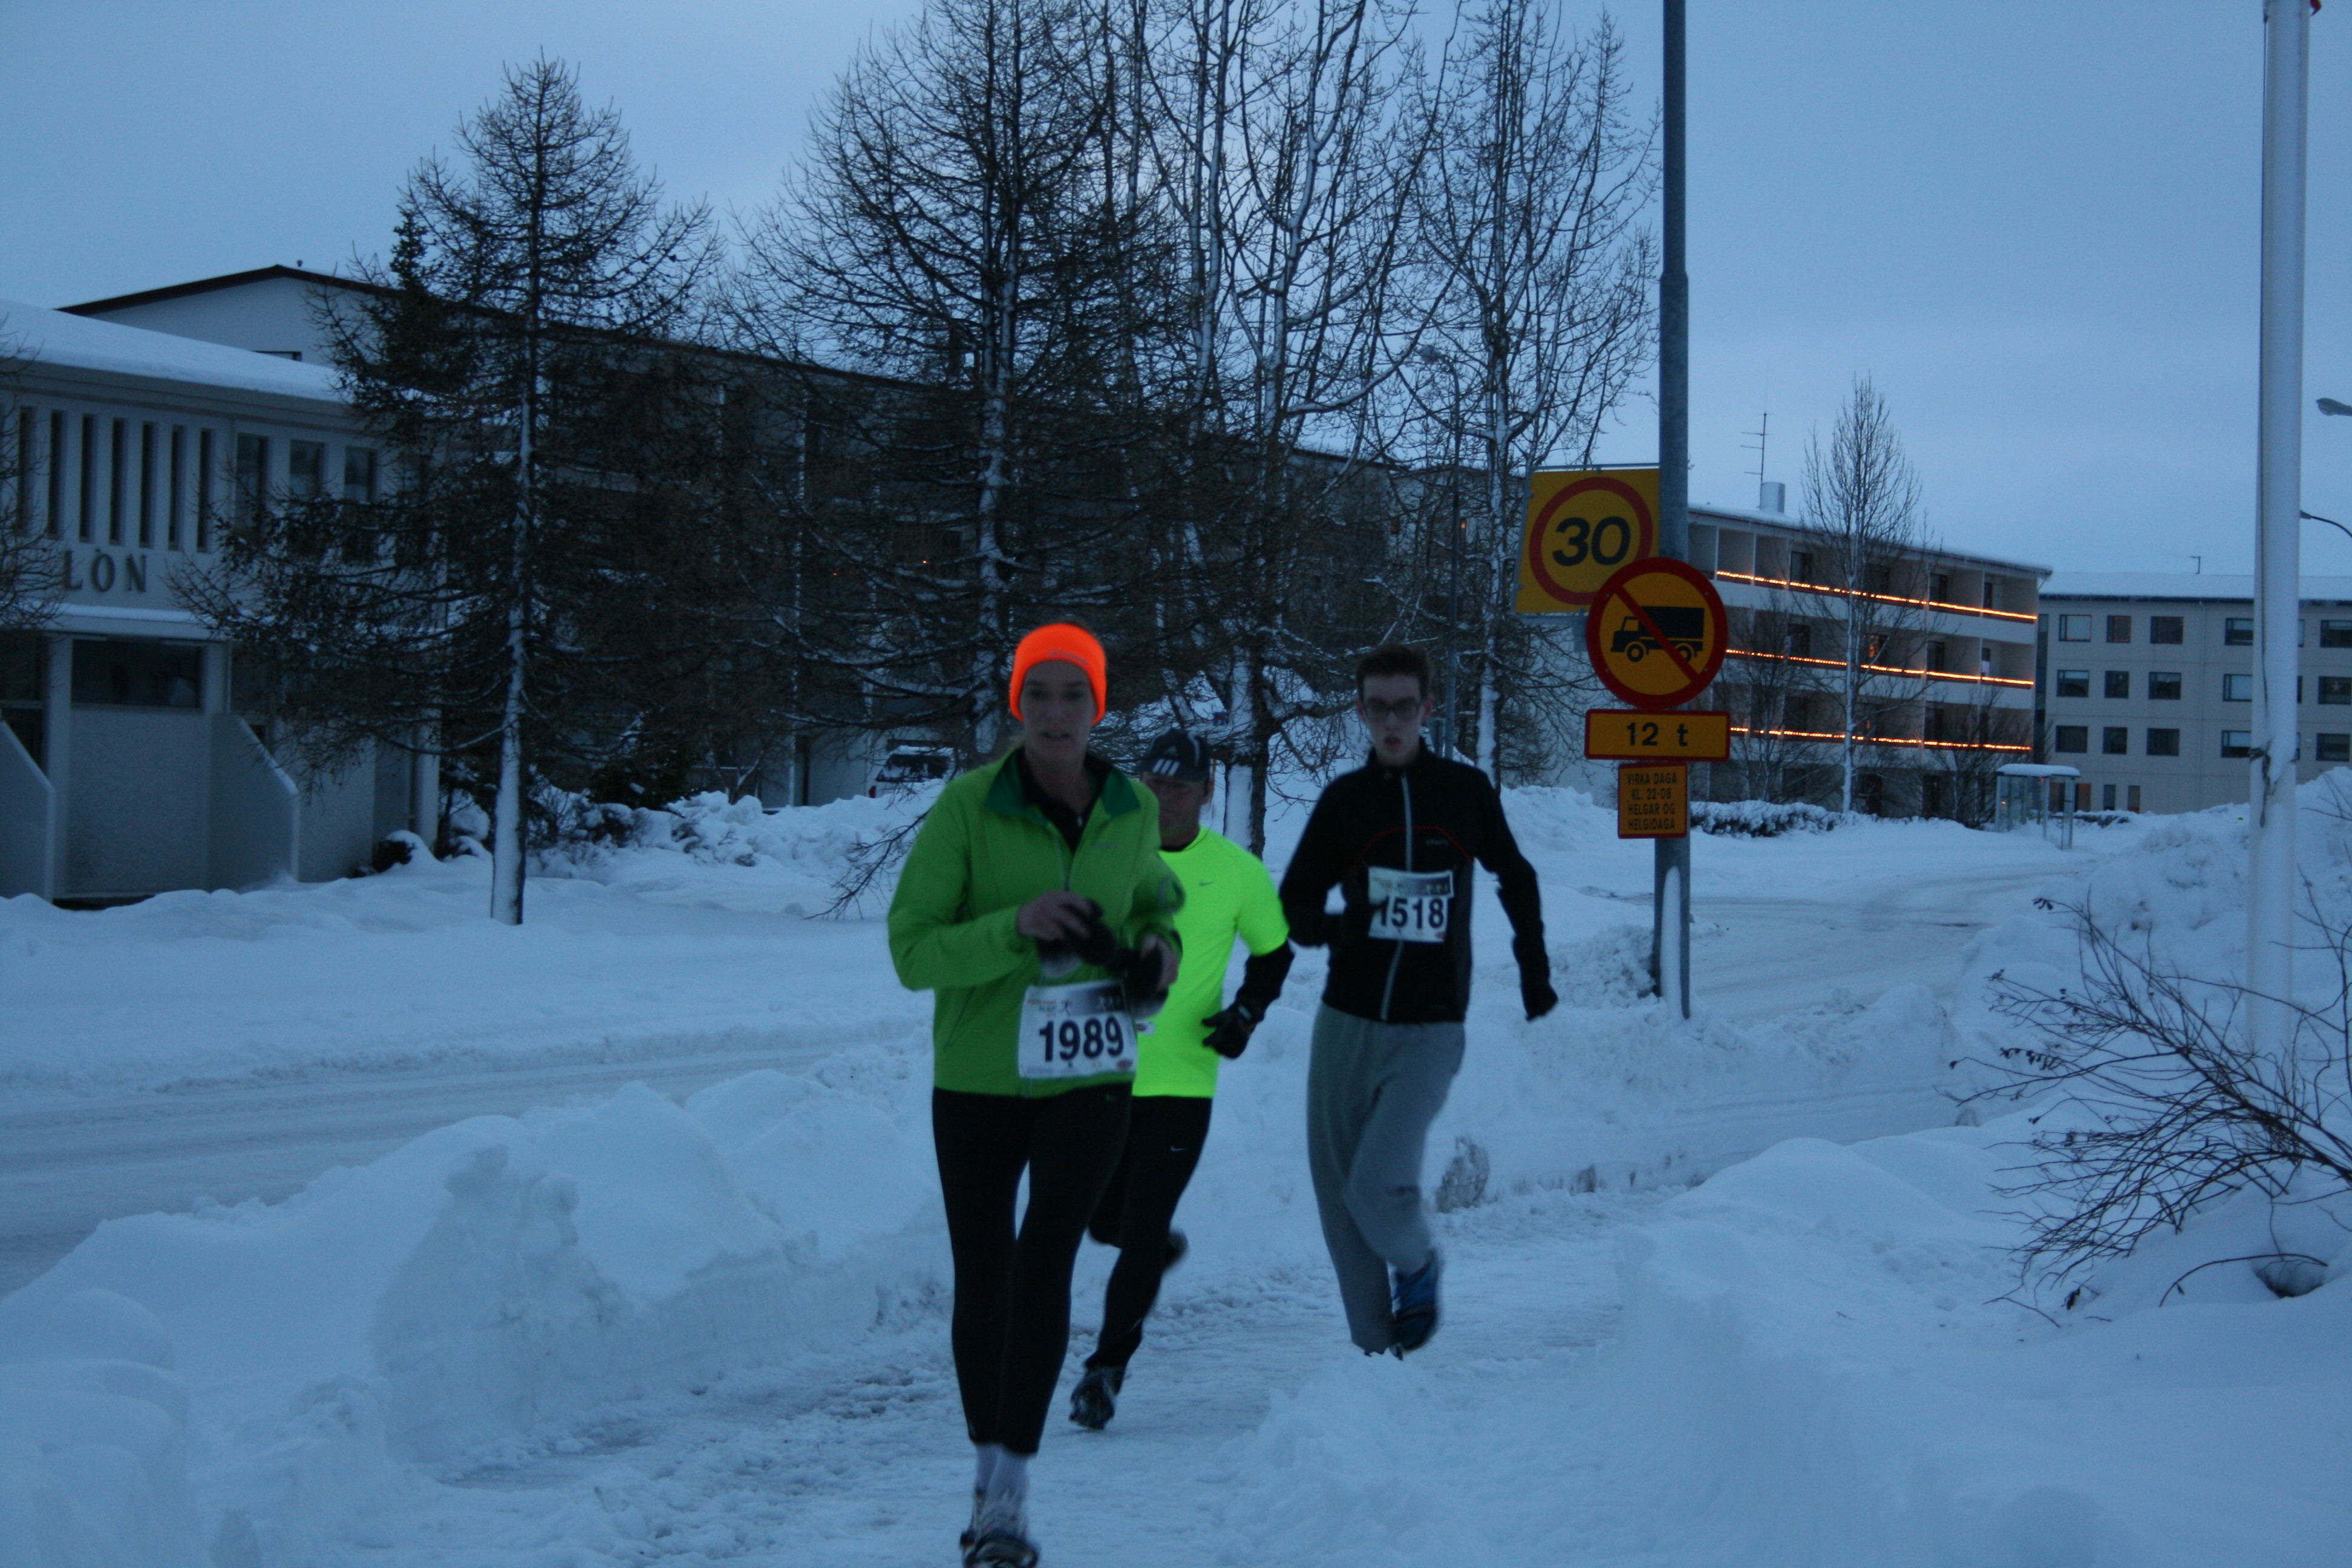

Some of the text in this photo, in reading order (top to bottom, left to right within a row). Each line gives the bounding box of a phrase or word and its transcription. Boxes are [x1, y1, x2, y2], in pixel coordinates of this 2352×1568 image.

[1552, 516, 1631, 566] 30
[1627, 722, 1689, 747] 12 t
[1627, 773, 1677, 785] VIRKA DAGA
[1646, 788, 1671, 800] 22-08
[1628, 803, 1676, 815] HELGAR OG
[1628, 818, 1675, 830] HELGIDAGA
[1379, 895, 1444, 930] 1518
[1039, 1016, 1124, 1062] 1989
